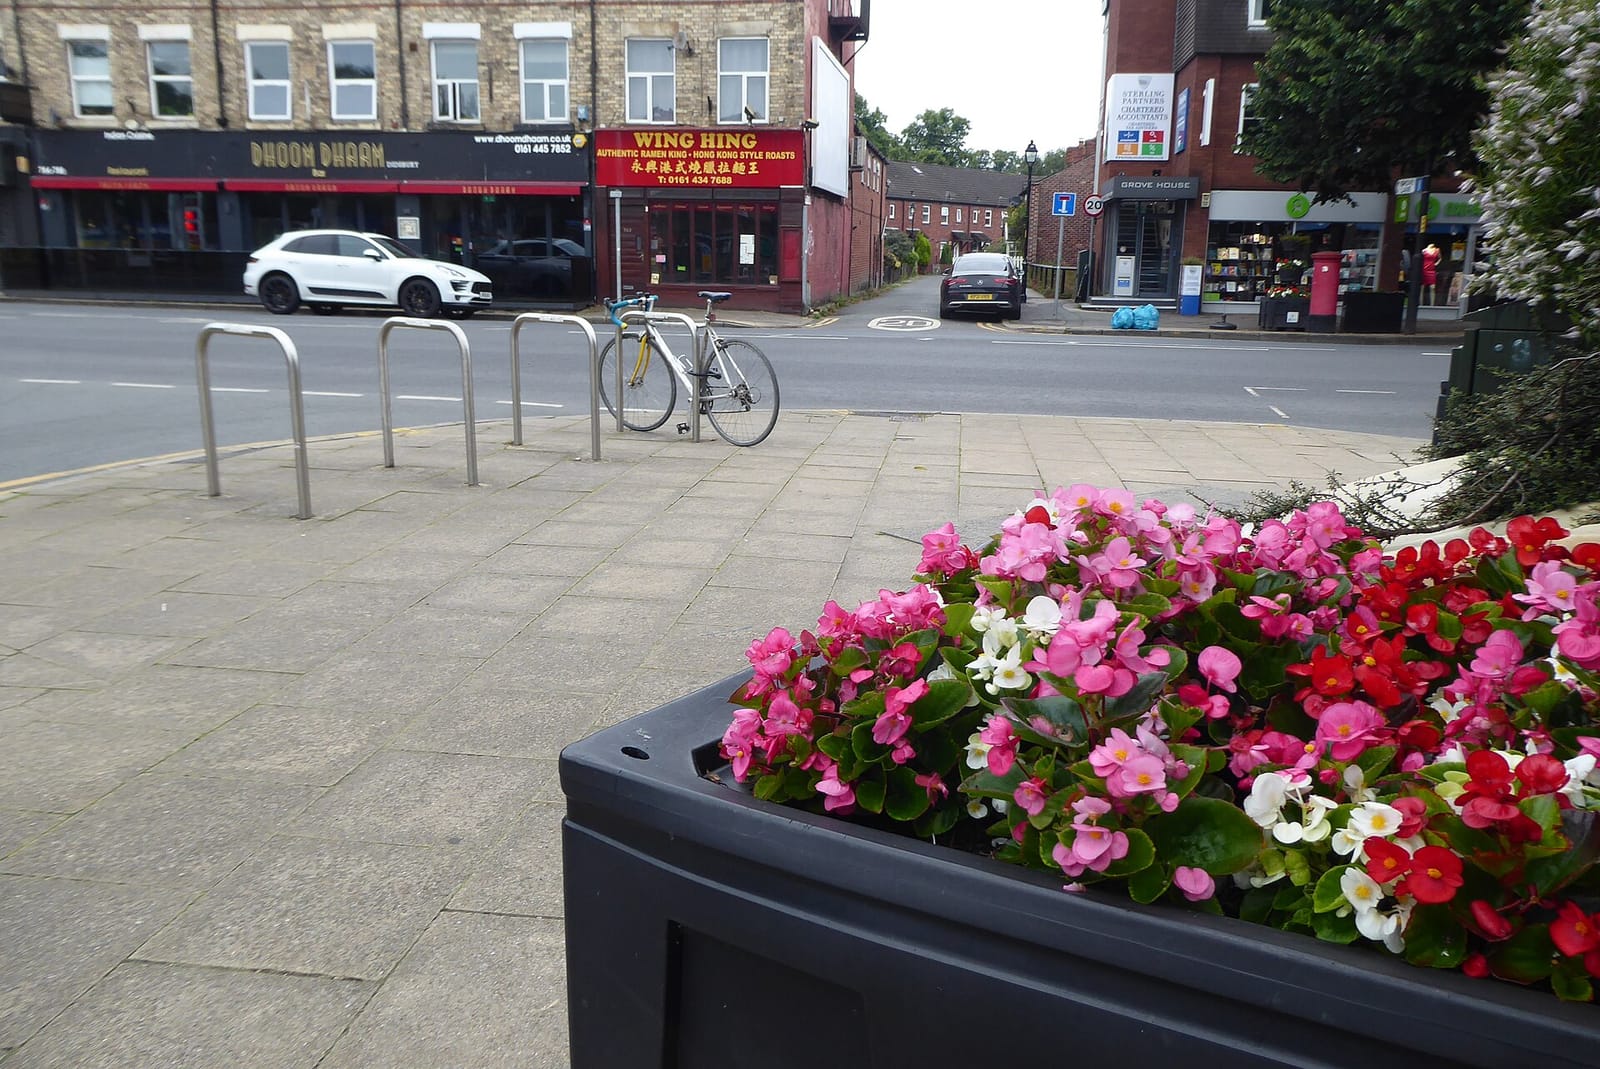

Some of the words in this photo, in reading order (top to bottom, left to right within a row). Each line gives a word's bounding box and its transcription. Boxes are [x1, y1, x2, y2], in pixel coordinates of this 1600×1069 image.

[1122, 90, 1165, 98] STERLING
[1122, 97, 1165, 105] PARTNERS
[1116, 113, 1168, 121] ACCOUNTANTS
[474, 134, 572, 143] www.dhoomdhaam.co.uk
[633, 132, 695, 148] WING
[700, 133, 758, 149] HING
[514, 144, 532, 153] 0161
[533, 144, 549, 153] 445
[550, 144, 571, 153] 7852
[250, 141, 316, 168] DHOOM
[319, 141, 385, 168] DHAAM
[596, 149, 639, 157] AUTHENTIC
[640, 149, 667, 158] RAMEN
[668, 150, 687, 158] KING
[693, 151, 715, 159] HONG
[716, 151, 738, 159] KONG
[740, 151, 764, 159] STYLE
[765, 152, 795, 160] ROASTS
[658, 176, 667, 184] T:
[668, 176, 689, 184] 0161
[691, 176, 709, 184] 434
[1087, 200, 1102, 210] 20
